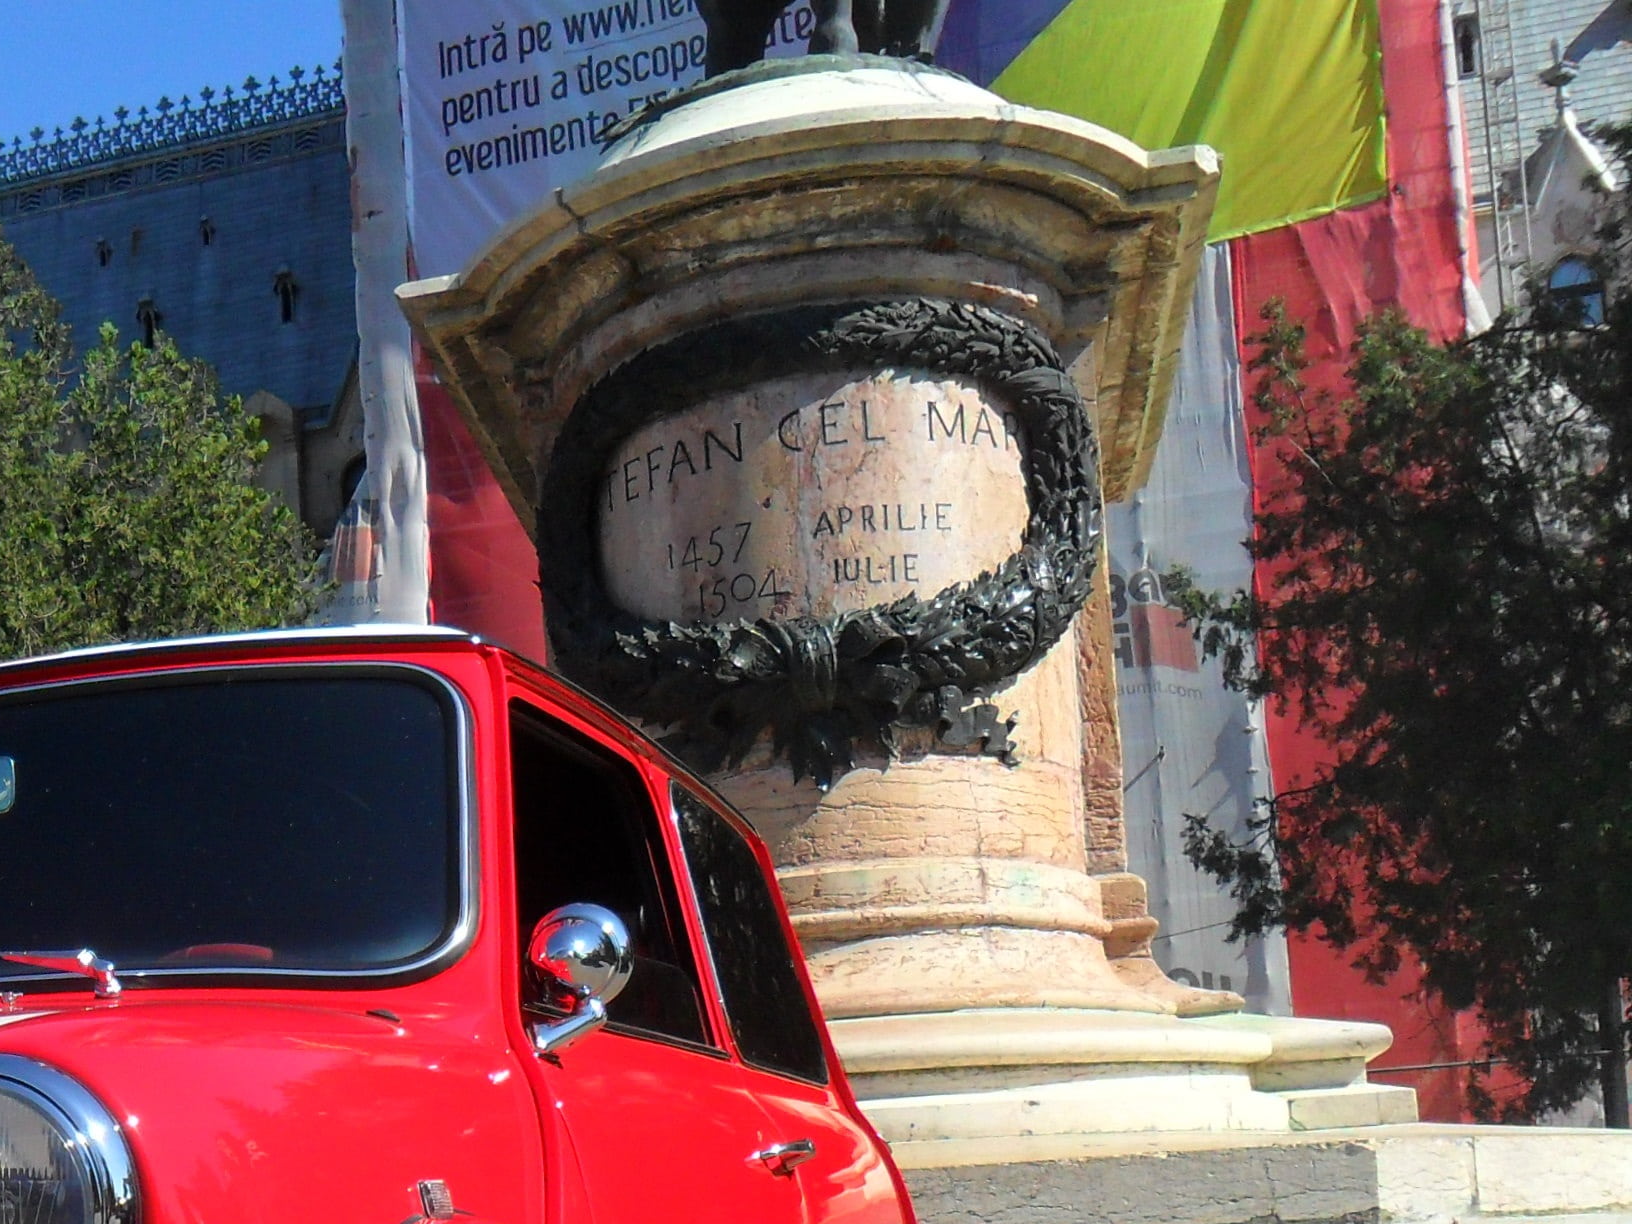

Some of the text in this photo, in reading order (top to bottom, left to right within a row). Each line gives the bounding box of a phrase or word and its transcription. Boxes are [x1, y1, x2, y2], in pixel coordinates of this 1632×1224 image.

[439, 21, 507, 79] Intră
[519, 20, 552, 64] pe
[441, 75, 540, 137] pentru
[551, 70, 568, 100] a
[577, 34, 705, 96] descope
[607, 422, 743, 512] TEFAN
[779, 401, 886, 453] CEL
[667, 503, 952, 573] 1457 APRILIE
[698, 553, 919, 620] 1504 IULIE
